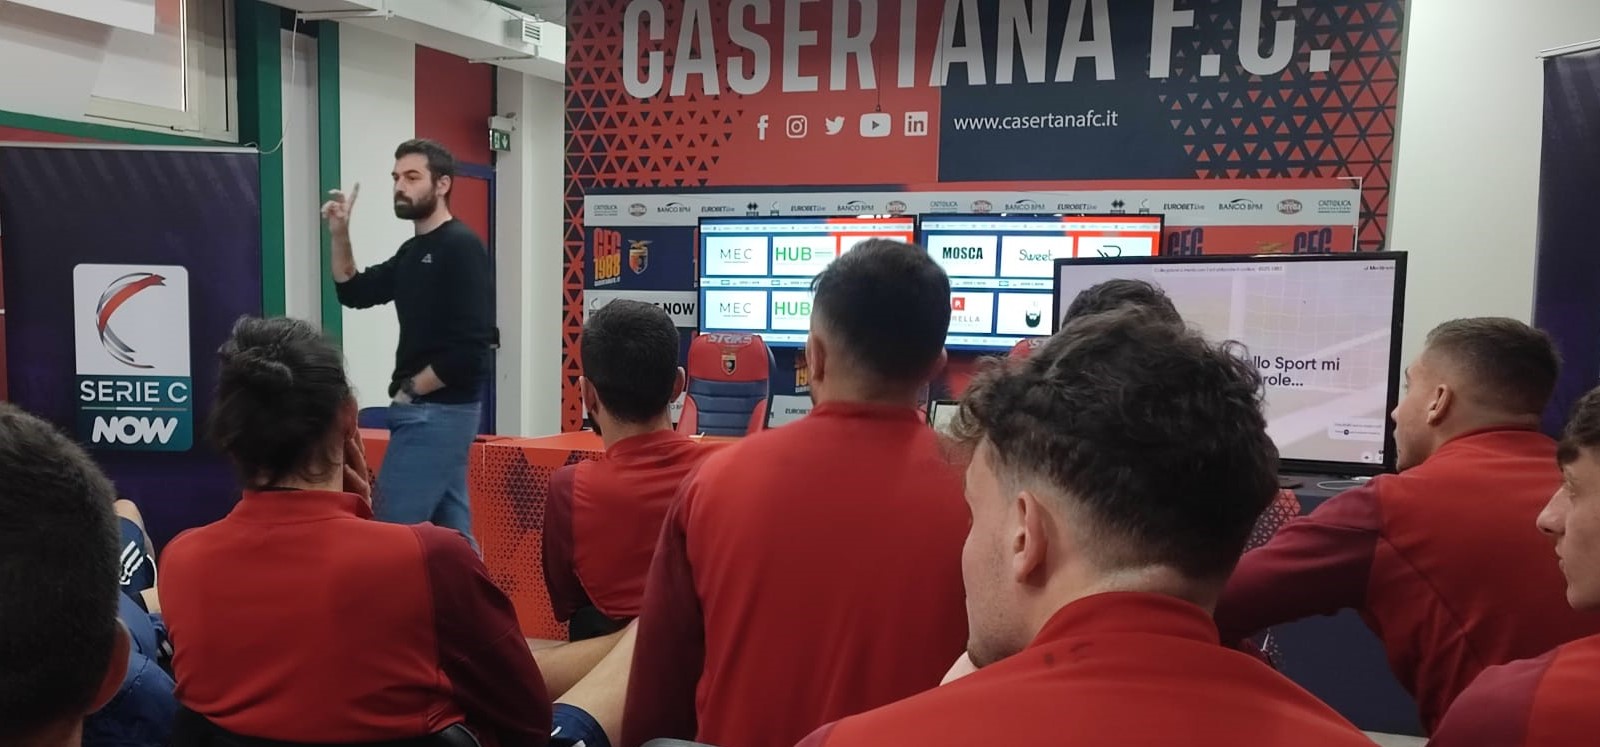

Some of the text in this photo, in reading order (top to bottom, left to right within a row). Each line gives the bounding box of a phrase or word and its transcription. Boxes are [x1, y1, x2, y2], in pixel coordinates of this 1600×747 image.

[622, 0, 1331, 98] CASERTANA F.C.
[953, 110, 1119, 130] www.casertanafc.it
[720, 248, 752, 260] MEC
[775, 246, 812, 261] HUB
[942, 247, 983, 260] MOSCA
[1019, 249, 1054, 261] Sweet
[663, 303, 695, 315] NOW
[719, 302, 752, 314] MEC
[774, 301, 811, 315] HUB
[1249, 356, 1340, 373] llo Sport mi
[1263, 373, 1304, 386] role...
[80, 380, 188, 403] SERIE C
[92, 416, 178, 444] NOW
